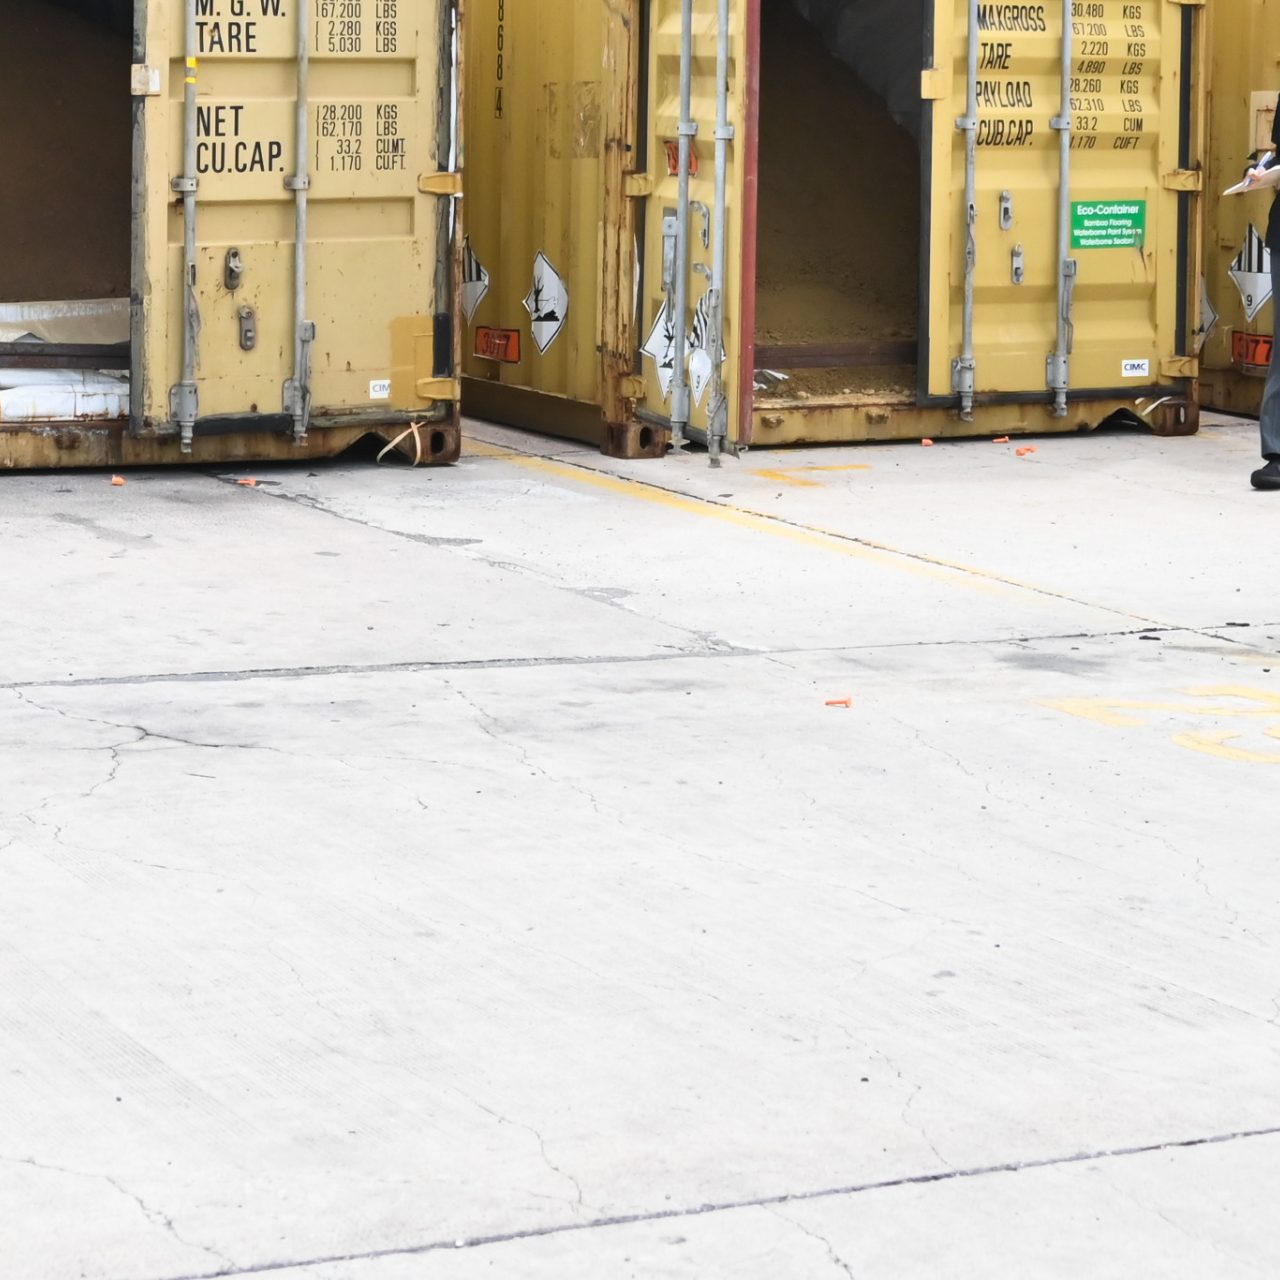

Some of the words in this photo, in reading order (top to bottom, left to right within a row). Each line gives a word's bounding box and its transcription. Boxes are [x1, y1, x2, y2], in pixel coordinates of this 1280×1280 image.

[376, 3, 397, 19] LBS
[976, 4, 1046, 32] MAXGROSS
[1122, 4, 1142, 20] KGS
[195, 22, 257, 53] TARE
[376, 21, 397, 37] KGS
[1125, 24, 1145, 38] LBS
[376, 37, 397, 53] LBS
[980, 42, 1013, 70] TARE
[1127, 43, 1146, 57] KGS
[1122, 62, 1143, 75] LBS
[975, 80, 1033, 108] PAYLOAD
[1120, 80, 1139, 95] KGS
[1122, 99, 1142, 113] LBS
[196, 106, 244, 137] NET
[376, 104, 398, 120] KGS
[376, 120, 398, 136] LBS
[976, 119, 1034, 146] CUB.CAP.
[1076, 116, 1098, 132] 33.2
[1123, 117, 1143, 132] CUM
[1113, 136, 1140, 150] CUFT
[195, 140, 285, 173] CU.CAP.
[336, 138, 362, 155] 33.2
[376, 138, 406, 155] CU.MT.
[376, 154, 406, 171] CU.FT.
[1077, 204, 1139, 216] Eco-Container
[1246, 294, 1253, 307] 9
[1124, 363, 1147, 372] CIMC
